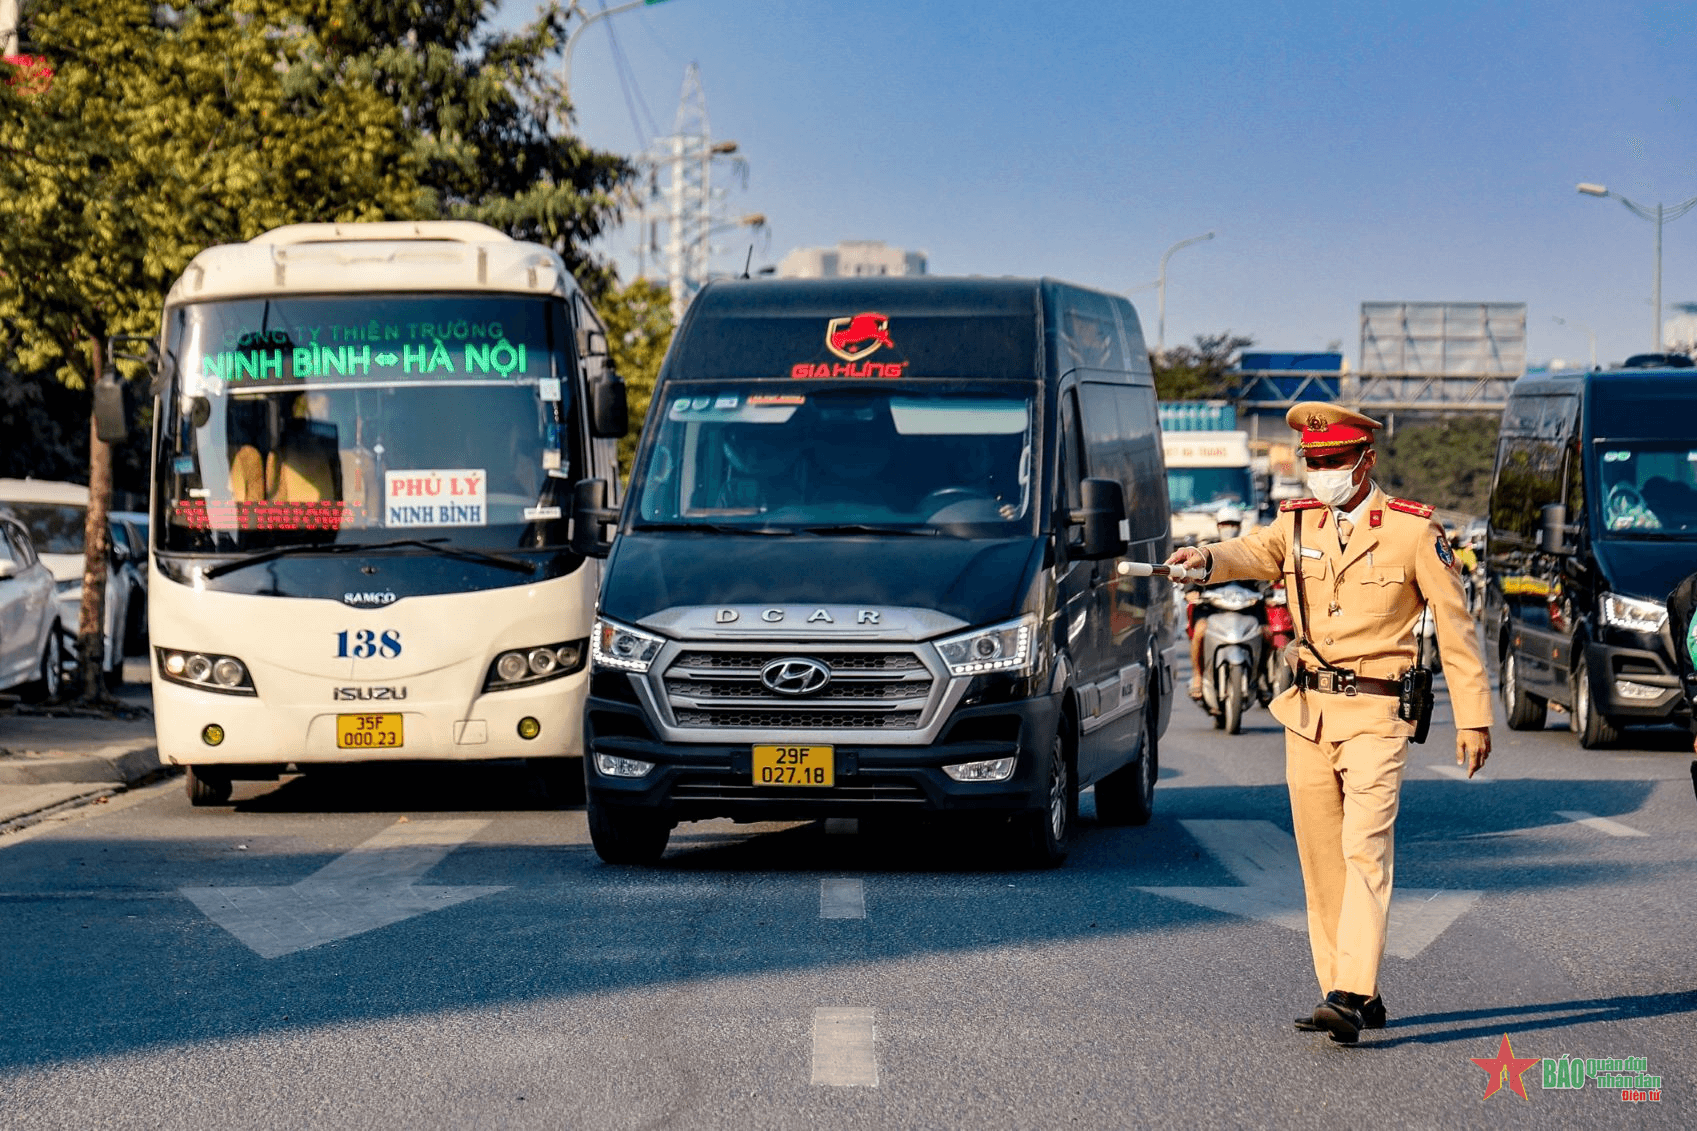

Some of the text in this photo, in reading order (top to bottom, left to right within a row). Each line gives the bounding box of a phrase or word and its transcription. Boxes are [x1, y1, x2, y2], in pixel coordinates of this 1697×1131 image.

[331, 319, 400, 342] THIÊN
[203, 337, 527, 380] NINH BÌNH HÀ NỘI
[391, 472, 481, 496] PHỦ LÝ
[390, 505, 433, 523] NINH
[440, 500, 480, 523] BÌNH
[344, 592, 397, 604] SAMCO
[333, 629, 402, 659] 138
[356, 716, 384, 731] 35F
[776, 748, 810, 765] 29F
[762, 766, 825, 784] 027.18
